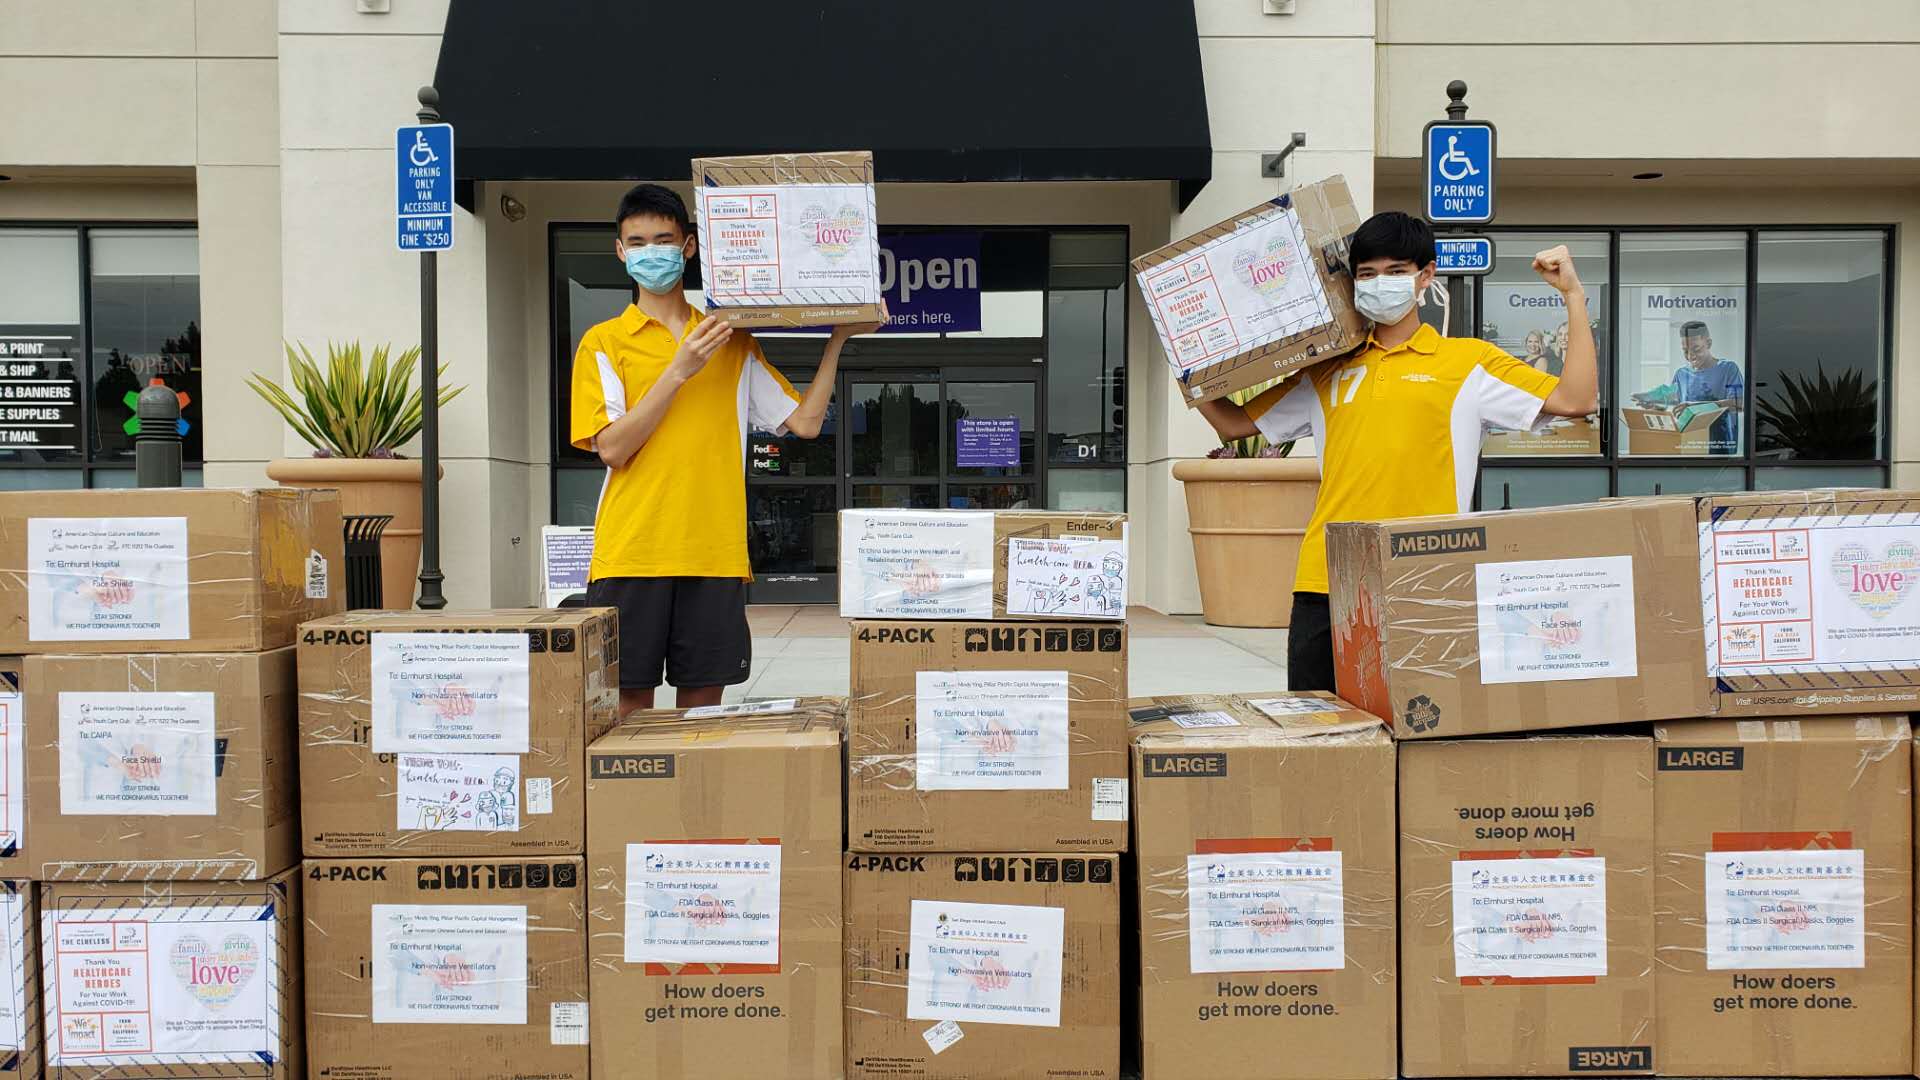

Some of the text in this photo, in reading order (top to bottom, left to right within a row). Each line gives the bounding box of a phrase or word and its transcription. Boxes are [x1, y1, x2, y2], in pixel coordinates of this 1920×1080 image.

[409, 167, 440, 178] PARKING
[415, 179, 434, 189] ONLY
[418, 191, 432, 200] VAN
[1434, 185, 1484, 197] PARKING
[404, 201, 447, 212] ACCESSIBLE
[1444, 199, 1474, 210] ONLY
[407, 219, 443, 231] MINIMUM
[815, 223, 851, 244] love
[401, 233, 449, 246] FINE $250
[1442, 243, 1477, 253] MINIMUM
[1436, 255, 1482, 266] FINE $250
[880, 248, 977, 303] Open
[1248, 259, 1286, 286] love
[1509, 294, 1589, 308] Creativ
[1648, 295, 1737, 308] Motivation
[922, 310, 954, 324] here.
[10, 343, 44, 354] PRINT
[10, 365, 36, 376] SHIP
[129, 355, 186, 375] OPEN
[1330, 364, 1368, 408] 17
[5, 387, 71, 398] & BANNERS
[7, 409, 60, 420] SUPPLIES
[10, 431, 39, 442] MAIL
[754, 443, 779, 454] FedEx
[1078, 445, 1096, 458] D1
[754, 460, 779, 468] FedEx
[1067, 522, 1113, 531] Ender-3
[1399, 532, 1480, 553] MEDIUM
[1840, 552, 1869, 562] family
[1888, 547, 1914, 558] giving
[58, 560, 120, 569] Elmhurst Hospital
[1733, 576, 1793, 588] HEALTHCARE
[1852, 564, 1904, 592] love
[1744, 589, 1782, 598] HEROES
[1540, 601, 1568, 610] Hospital
[1732, 609, 1759, 617] Against
[1560, 620, 1581, 628] Shield
[858, 628, 935, 643] 4-PACK
[1734, 629, 1747, 638] We
[434, 672, 463, 680] Hospital
[459, 691, 497, 699] Ventilators
[1843, 695, 1875, 703] Supplies
[978, 710, 1005, 718] Hospital
[1002, 728, 1038, 736] Ventilators
[1667, 751, 1734, 766] LARGE
[599, 759, 666, 774] LARGE
[1152, 757, 1218, 773] LARGE
[1511, 806, 1559, 818] more
[1565, 803, 1594, 820] get
[1475, 826, 1575, 842] How doers
[848, 856, 925, 872] 4-PACK
[310, 866, 387, 881] 4-PACK
[690, 882, 718, 890] Hospital
[1253, 890, 1280, 899] Hospital
[1772, 889, 1800, 897] Hospital
[1517, 896, 1544, 905] Hospital
[687, 912, 715, 920] Surgical
[718, 912, 740, 920] Masks,
[743, 911, 770, 921] Goggles
[178, 943, 207, 954] family
[224, 941, 250, 950] giving
[433, 943, 462, 951] Hospital
[939, 946, 970, 955] Elmhurst
[972, 948, 999, 957] Hospital
[73, 968, 133, 978] HEALTHCARE
[190, 957, 239, 985] love
[949, 967, 1032, 978] Non-invasive Ventilators
[84, 979, 121, 988] HEROES
[1733, 974, 1836, 989] How doers
[665, 983, 764, 998] How doers
[1218, 981, 1318, 997] How doers
[73, 1000, 98, 1008] Against
[1713, 995, 1744, 1012] get
[1749, 995, 1798, 1010] more
[645, 1005, 675, 1023] get
[680, 1005, 728, 1018] more
[1198, 1003, 1228, 1020] get
[1234, 1003, 1282, 1016] more
[1578, 1051, 1644, 1067] LARGE
